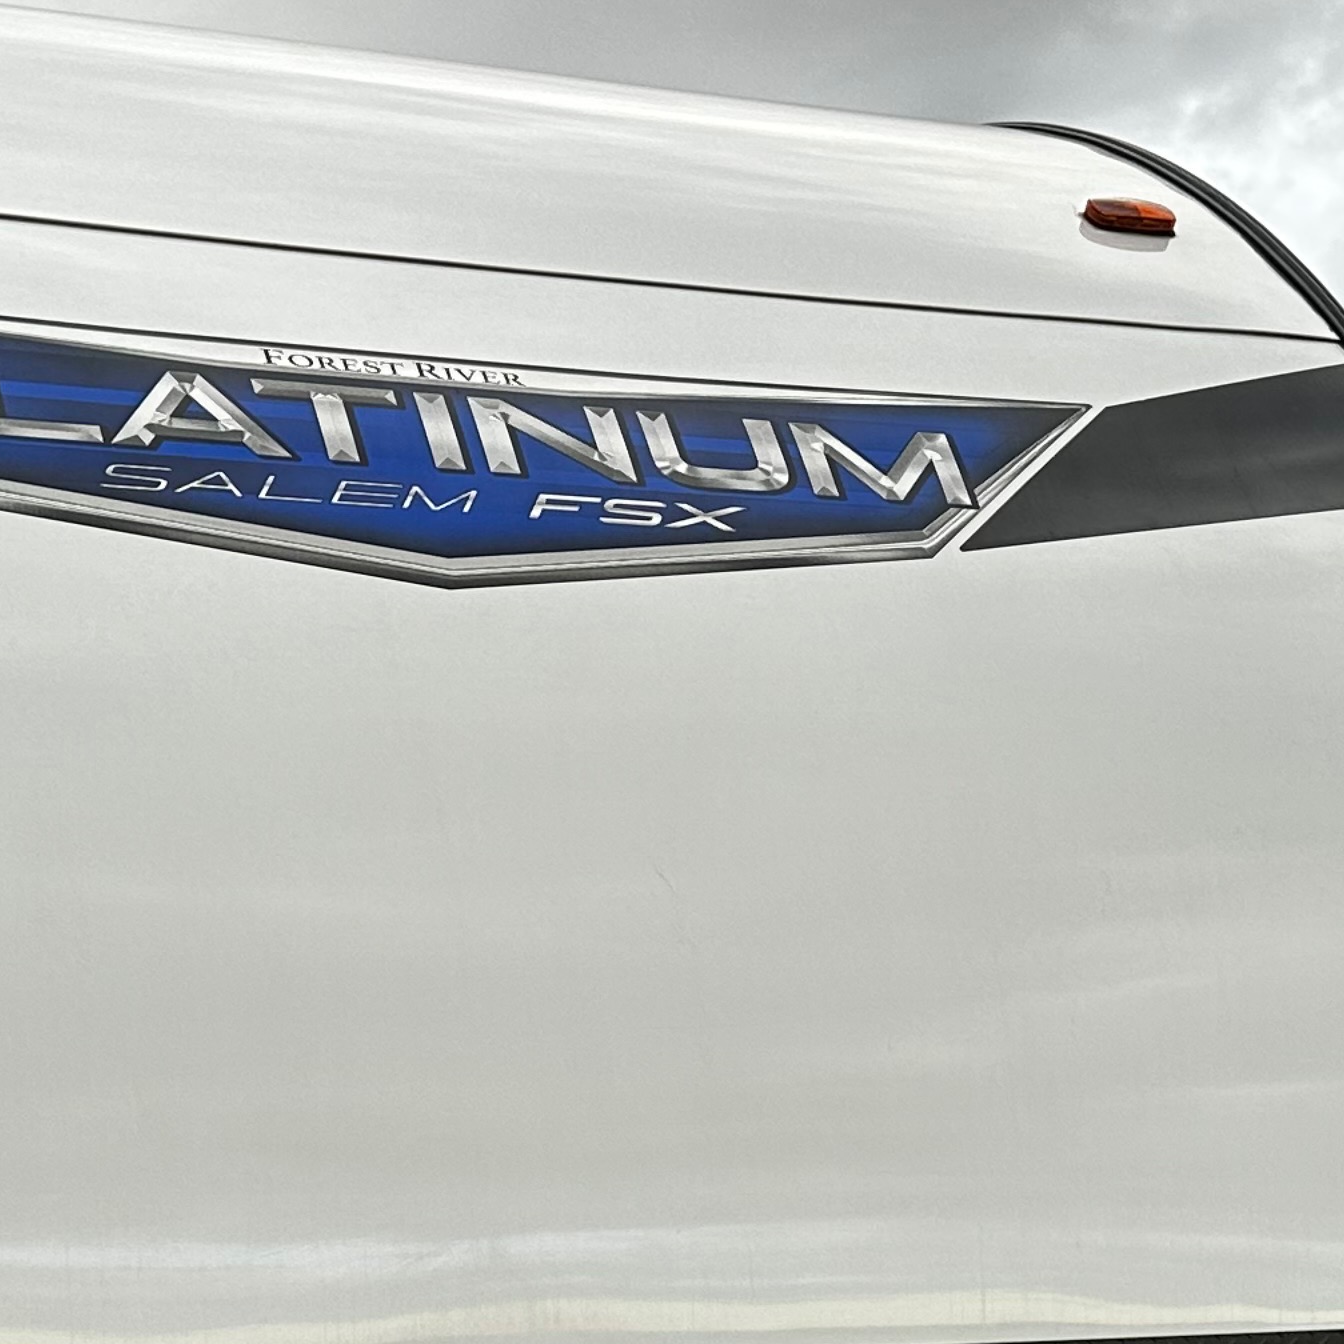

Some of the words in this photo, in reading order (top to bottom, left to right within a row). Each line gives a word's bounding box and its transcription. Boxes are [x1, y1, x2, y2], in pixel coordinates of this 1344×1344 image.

[259, 348, 404, 376] FOREST
[414, 361, 527, 387] RIVER
[99, 462, 479, 514] SALEM
[528, 492, 747, 533] FSX
